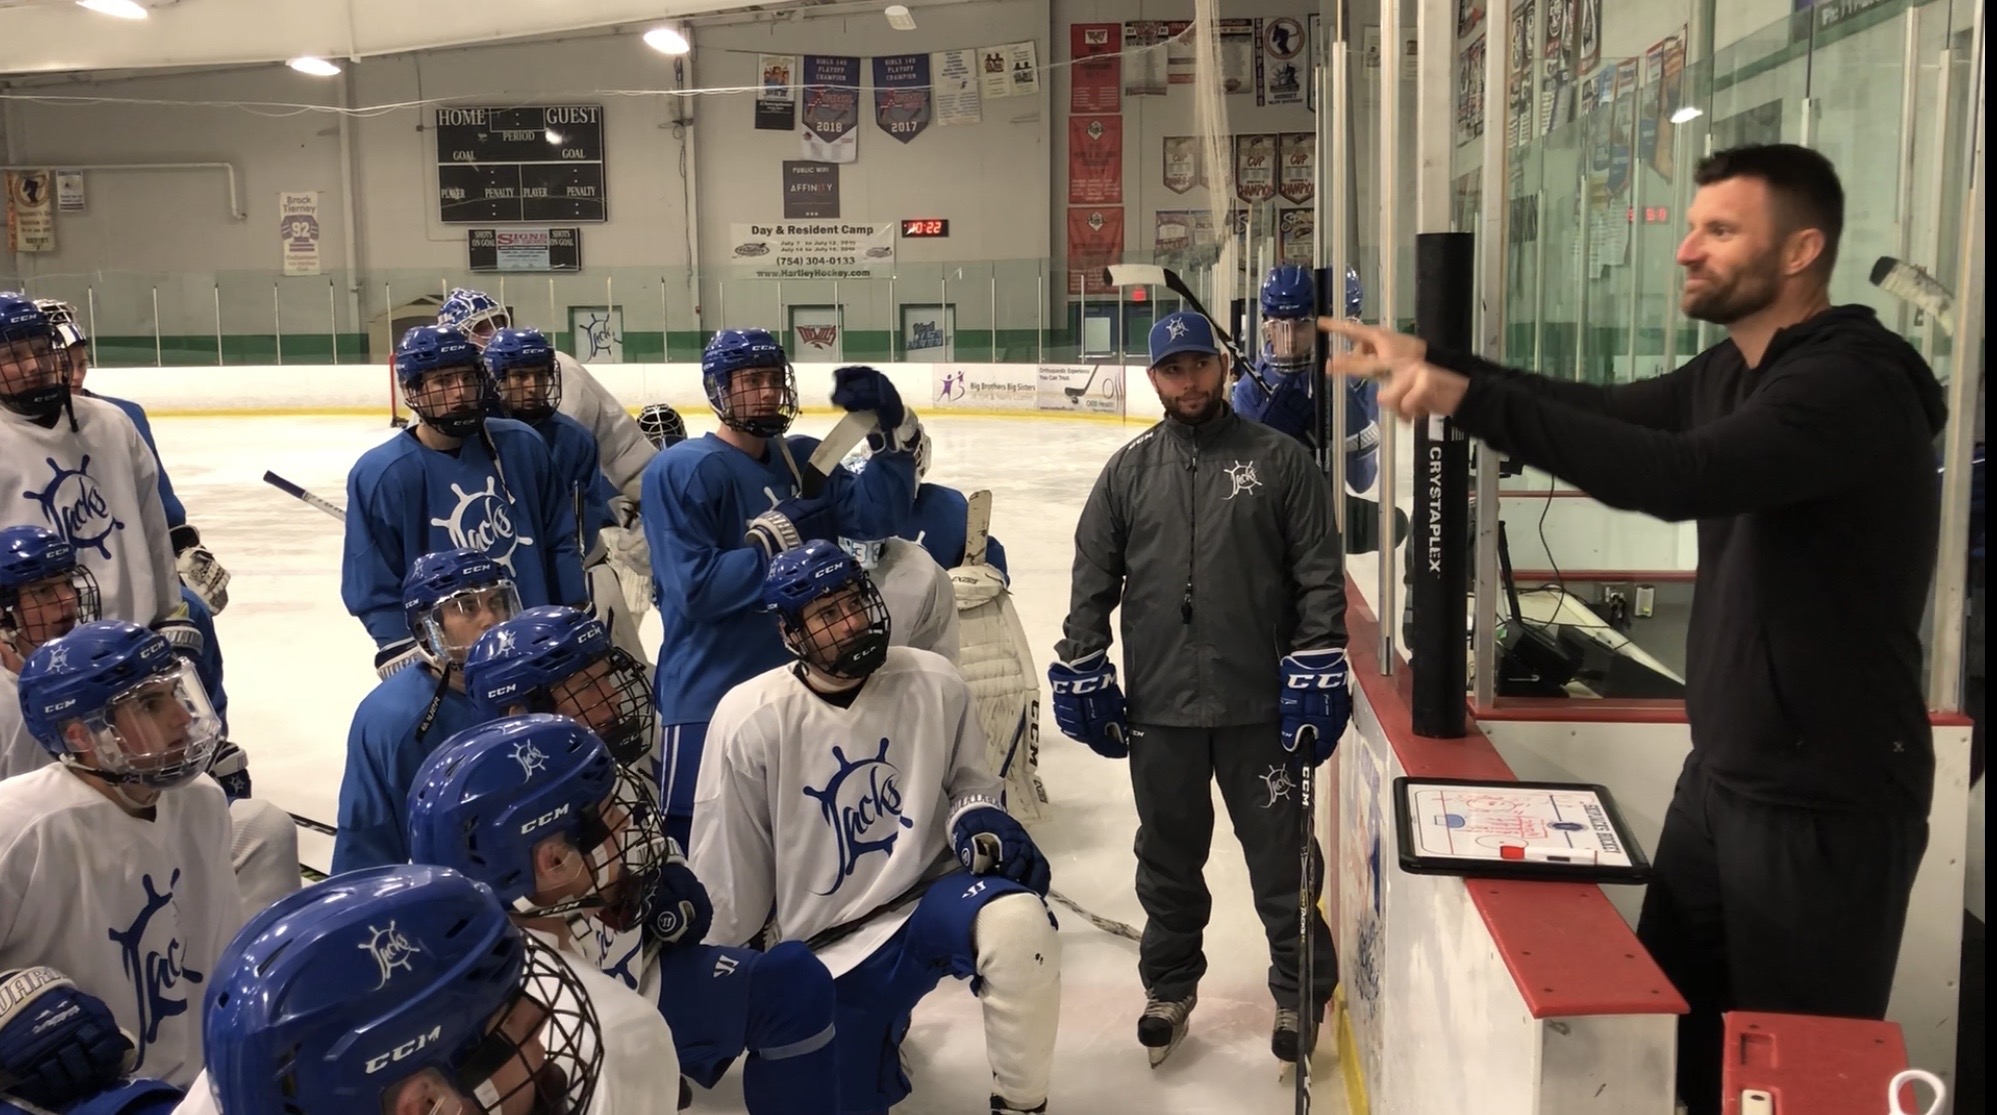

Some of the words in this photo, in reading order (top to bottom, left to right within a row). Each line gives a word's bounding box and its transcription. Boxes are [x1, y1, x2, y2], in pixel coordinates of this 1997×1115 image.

[439, 110, 486, 126] HOME
[546, 107, 597, 124] GUEST
[816, 122, 842, 132] 2018
[892, 122, 917, 132] 2017
[503, 131, 535, 141] PERIOD
[453, 150, 476, 160] GOAL
[562, 149, 585, 159] GOAL
[1290, 153, 1308, 165] CUP
[1247, 156, 1266, 167] CUP
[485, 188, 514, 198] PENALTY
[523, 188, 548, 197] PLAYER
[566, 186, 595, 196] PENALTY
[287, 196, 311, 204] Brock
[283, 204, 316, 214] Tierney
[292, 222, 310, 237] 92
[752, 226, 772, 236] Day
[776, 226, 784, 234] &
[788, 225, 838, 234] Resident
[842, 225, 874, 236] Camp
[776, 257, 804, 266] (754)
[806, 257, 855, 265] 304-0133
[10, 314, 37, 323] CCM
[441, 344, 466, 353] CCM
[970, 382, 980, 392] Big
[1007, 382, 1016, 392] Big
[1017, 383, 1035, 391] Sisters
[1429, 446, 1442, 572] CRYSTAPLEX
[46, 547, 69, 559] CCM
[463, 564, 491, 575] CCM
[815, 562, 843, 578] CCM
[578, 625, 602, 644] CCM
[140, 641, 165, 659] CCM
[1052, 673, 1116, 694] CCM
[488, 684, 516, 698] CCM
[44, 699, 76, 713] CCM
[1029, 700, 1040, 767] CCM
[1302, 766, 1310, 806] CCM
[521, 803, 570, 834] CCM
[539, 902, 580, 916] CCM
[364, 1024, 441, 1074] CCM
